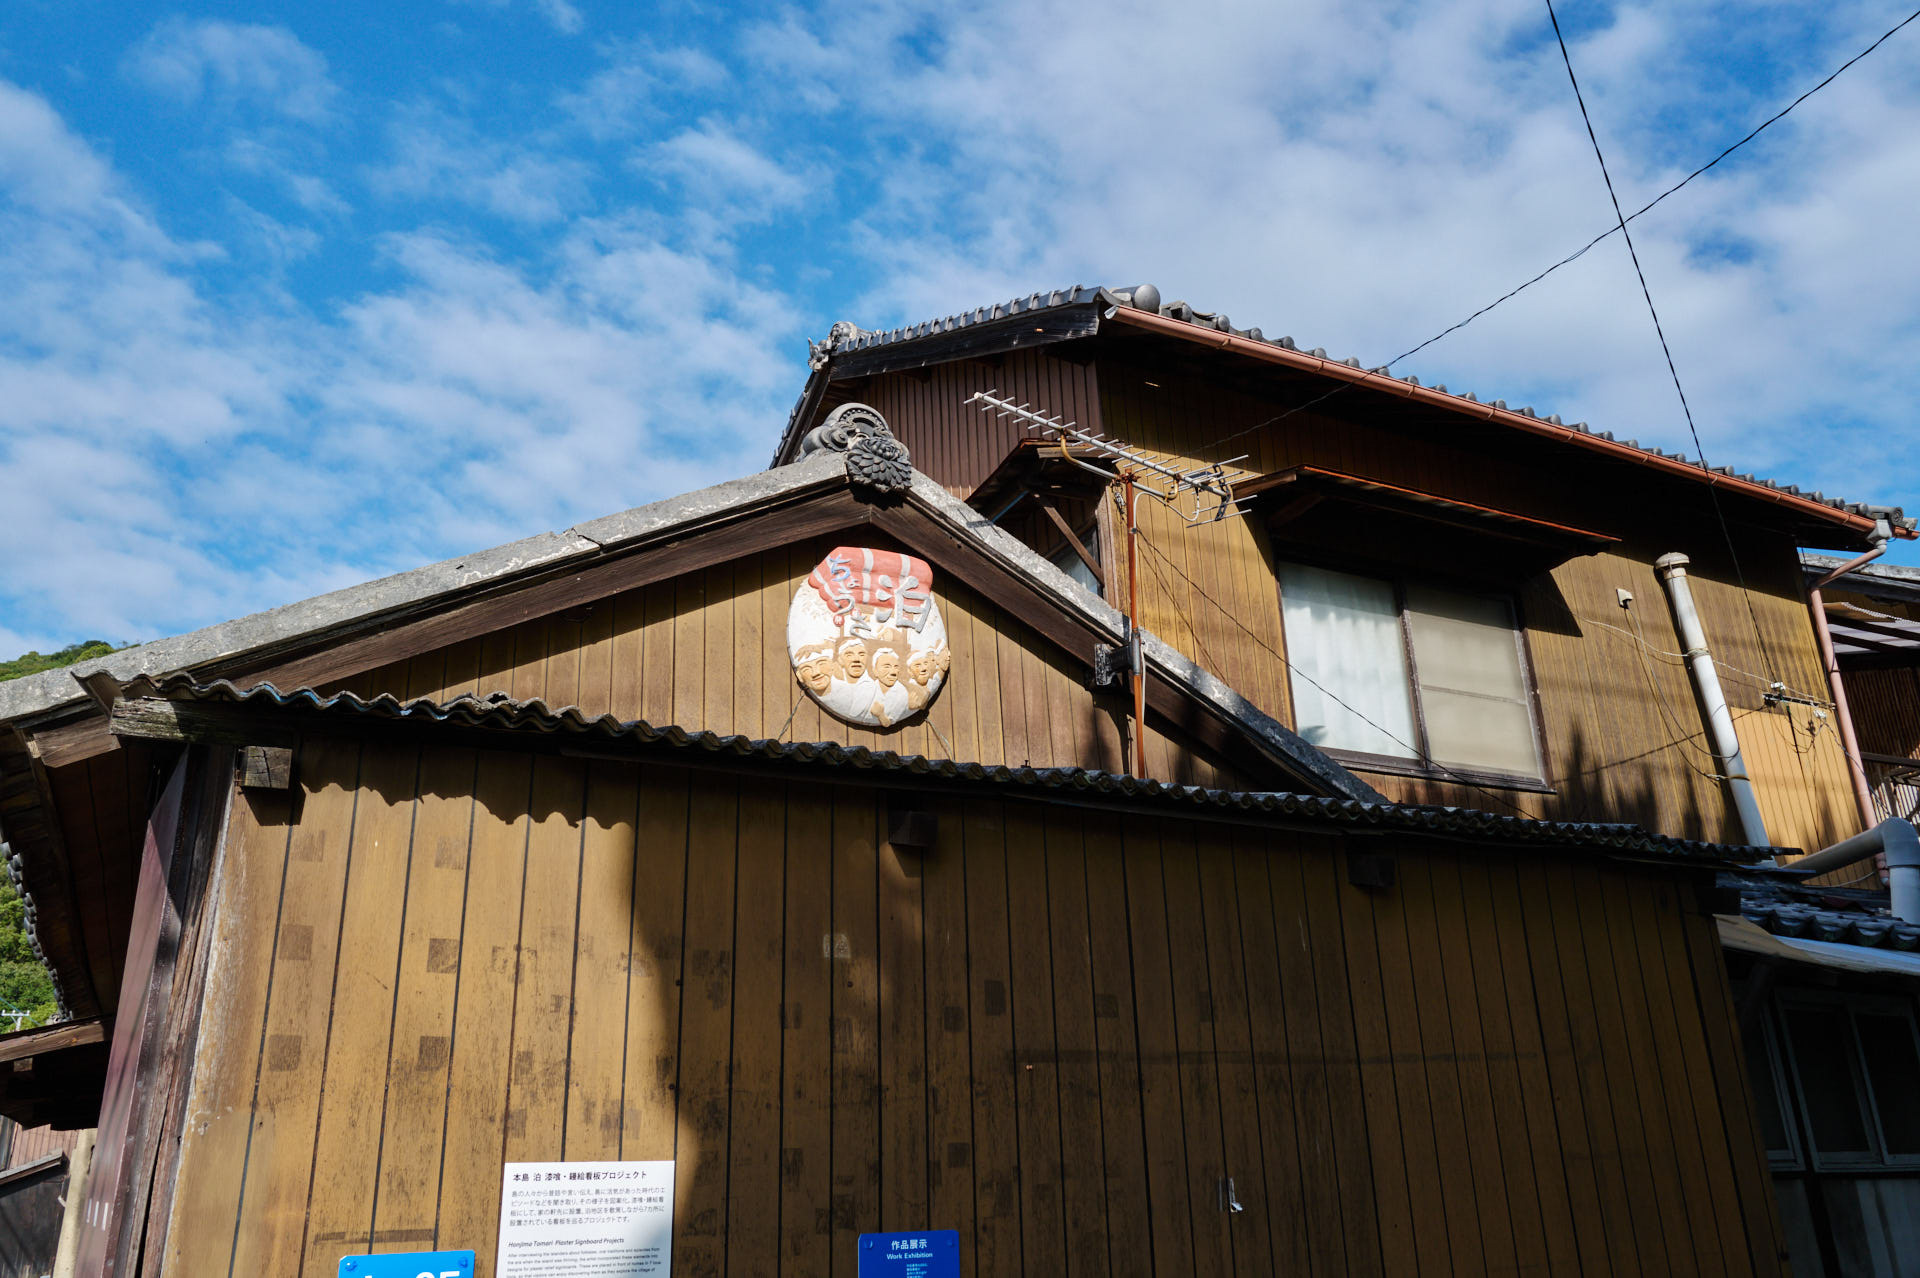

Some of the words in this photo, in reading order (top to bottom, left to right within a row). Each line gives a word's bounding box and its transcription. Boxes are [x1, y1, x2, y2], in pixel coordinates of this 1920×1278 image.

[875, 574, 931, 634] 泊
[513, 1172, 529, 1182] 本島
[533, 1172, 542, 1181] 泊
[575, 1238, 602, 1246] Signboard
[604, 1237, 624, 1245] Projects
[891, 1239, 928, 1250] 作品展示
